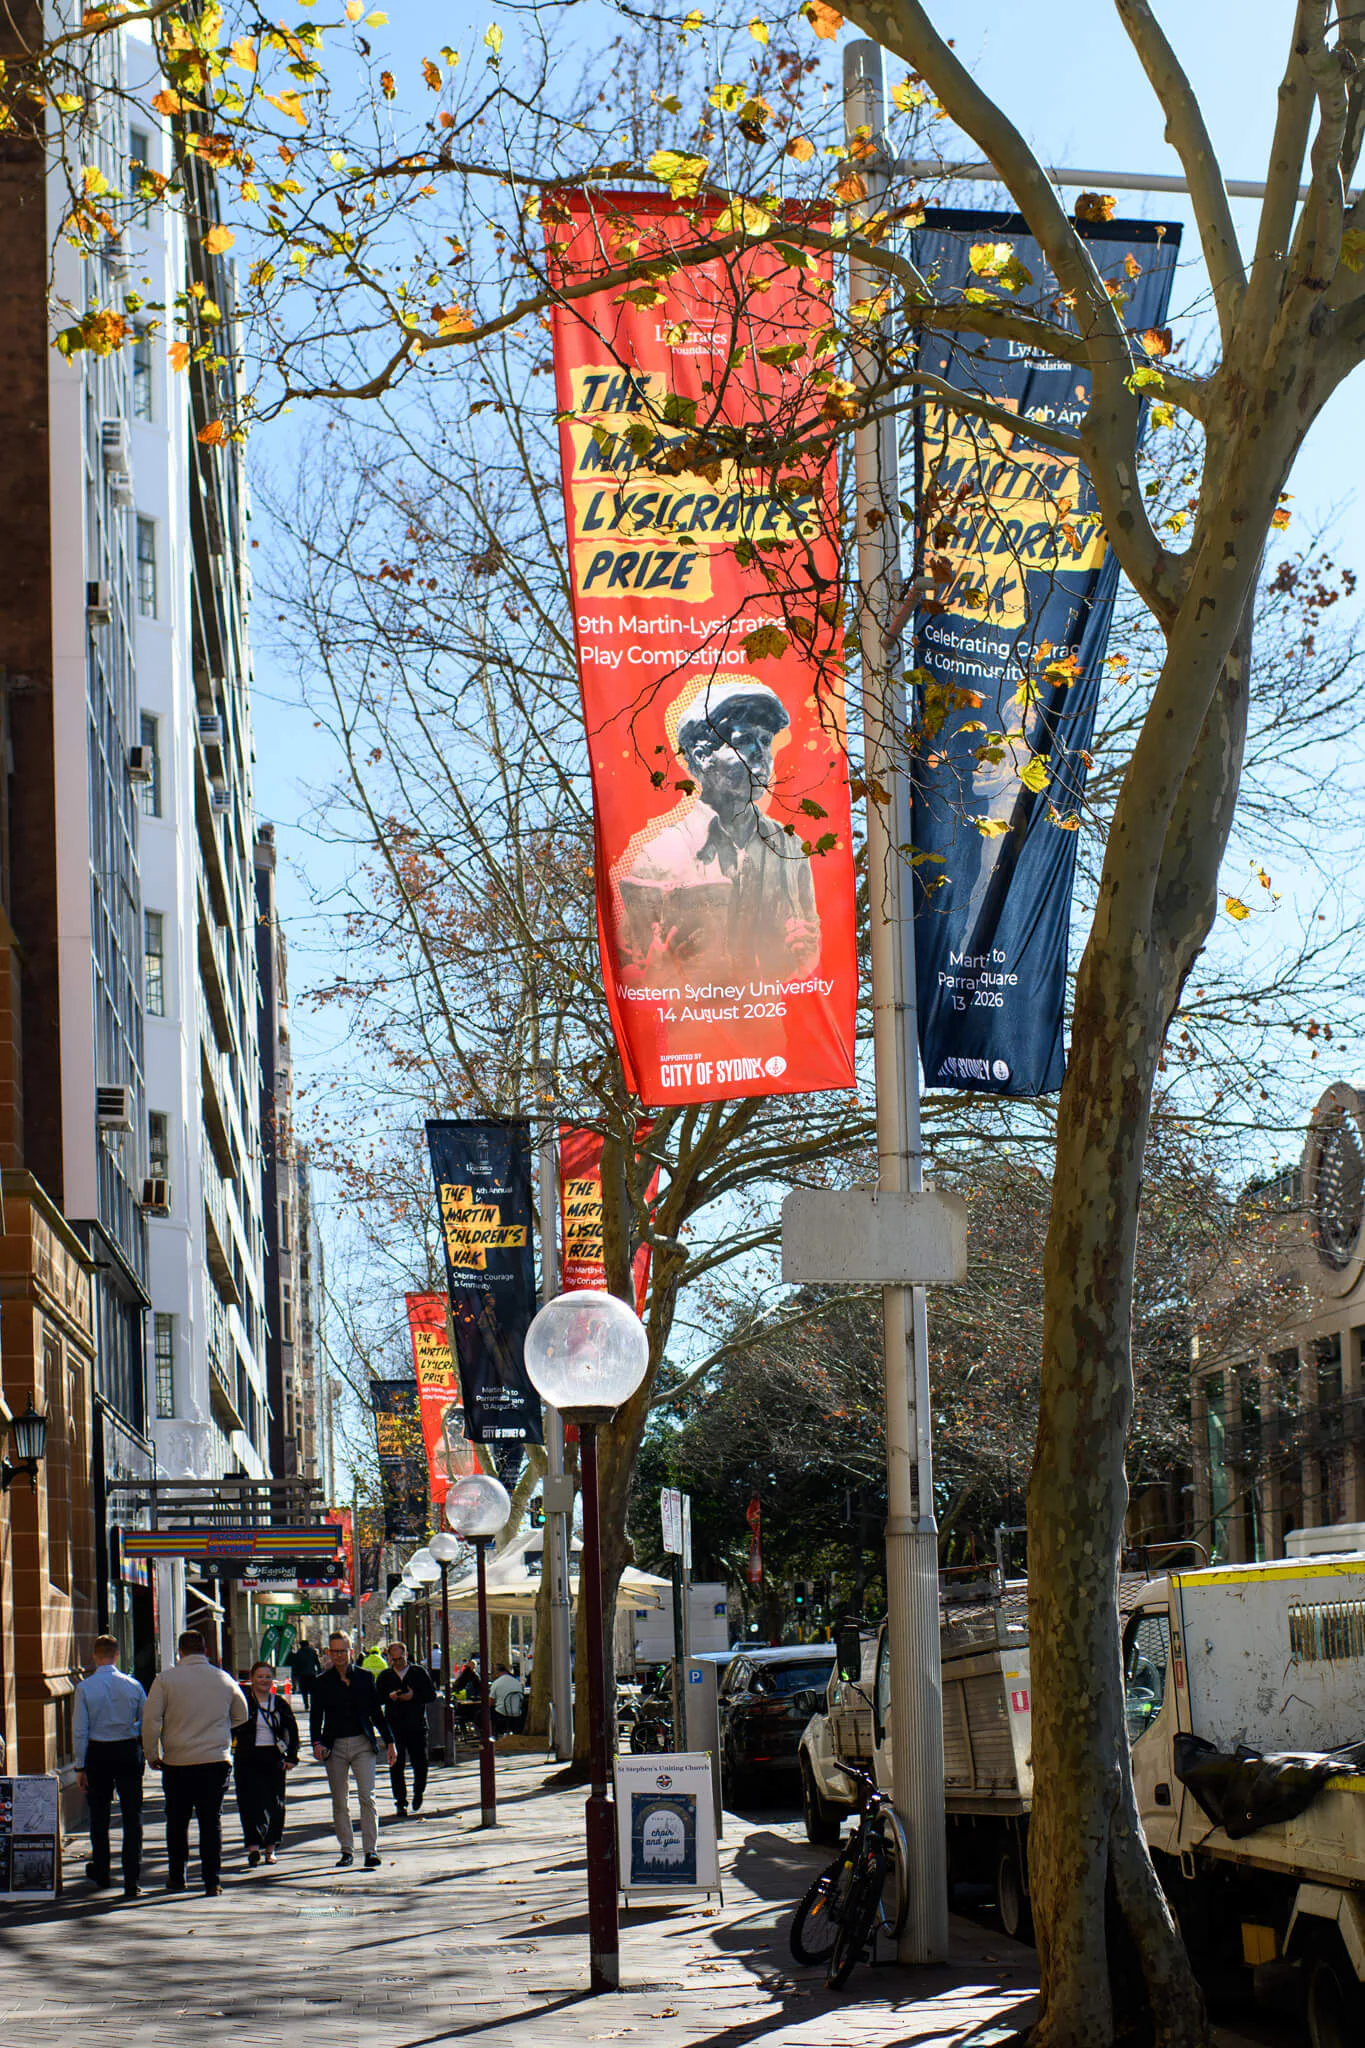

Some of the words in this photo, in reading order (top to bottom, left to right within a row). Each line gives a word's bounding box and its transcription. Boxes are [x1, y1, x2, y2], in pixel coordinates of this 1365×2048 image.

[583, 374, 651, 413] THE
[1024, 406, 1055, 421] 4h
[583, 551, 698, 590] PRIZE
[578, 616, 612, 634] 9th
[924, 624, 1010, 660] Celebrating
[581, 646, 622, 669] Play
[924, 651, 932, 665] &
[993, 948, 1006, 963] to
[980, 972, 1018, 988] quare
[616, 984, 680, 1001] Western
[685, 983, 746, 1002] Sydney
[750, 977, 834, 997] University
[951, 995, 966, 1011] 13
[974, 990, 1004, 1007] 2026
[656, 1007, 676, 1022] 14
[680, 1003, 739, 1023] August
[743, 1002, 787, 1018] 2026
[661, 1063, 692, 1087] CITY
[696, 1061, 713, 1085] OF
[445, 1187, 467, 1201] THE
[568, 1181, 596, 1196] THE
[446, 1208, 497, 1222] MARTIN
[567, 1203, 603, 1217] MART
[567, 1224, 604, 1238] LYSIC
[691, 1671, 700, 1683] P
